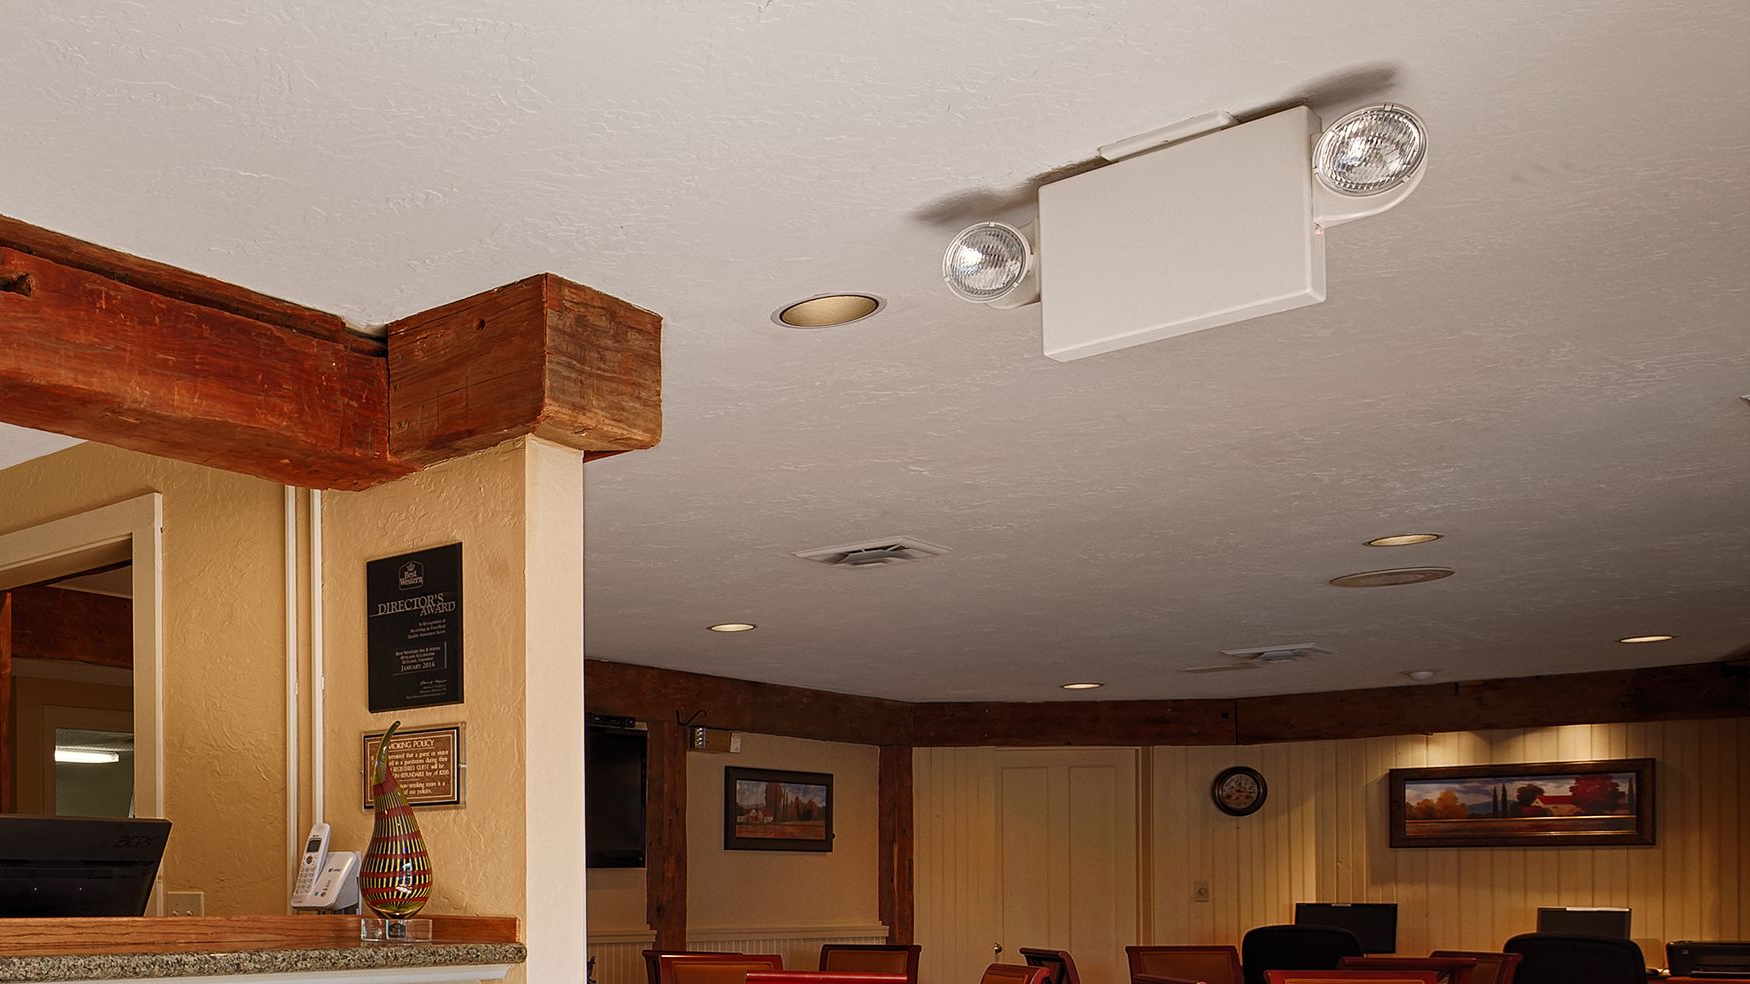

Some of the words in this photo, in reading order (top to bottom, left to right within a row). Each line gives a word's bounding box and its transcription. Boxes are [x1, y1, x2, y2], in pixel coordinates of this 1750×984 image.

[378, 593, 444, 616] DIRECTOR'S
[420, 600, 456, 617] AWARD
[388, 740, 412, 750] MOKING
[413, 740, 434, 748] POLICY
[114, 835, 160, 848] acer
